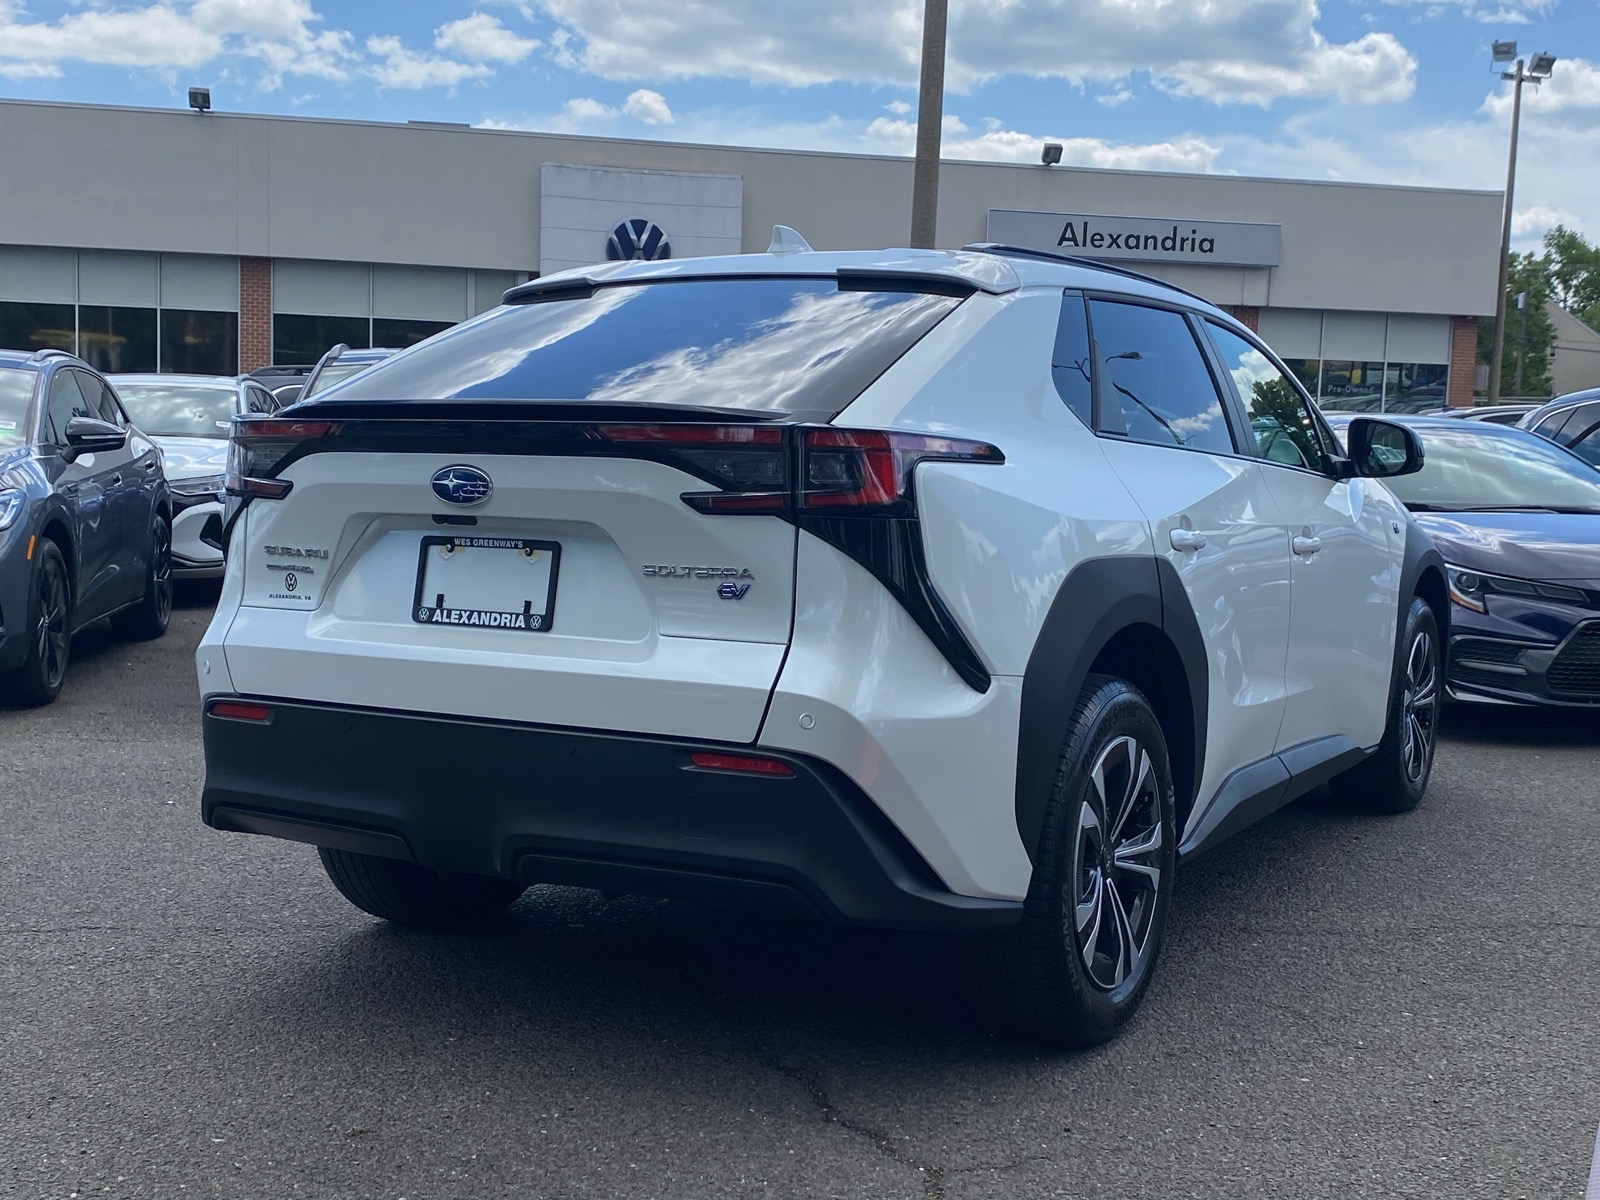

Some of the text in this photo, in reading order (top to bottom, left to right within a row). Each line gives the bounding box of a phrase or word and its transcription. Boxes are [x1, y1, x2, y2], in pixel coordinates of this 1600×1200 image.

[1056, 221, 1215, 254] Alexandria
[1327, 384, 1375, 395] Pre-Owned
[454, 538, 523, 549] WES GREENWAY'S
[264, 545, 329, 560] SUBARU
[643, 564, 755, 580] SOLTERRA
[269, 593, 303, 601] ALEXANDRIA,
[716, 581, 751, 600] EV
[432, 608, 527, 629] ALEXANDRIA
